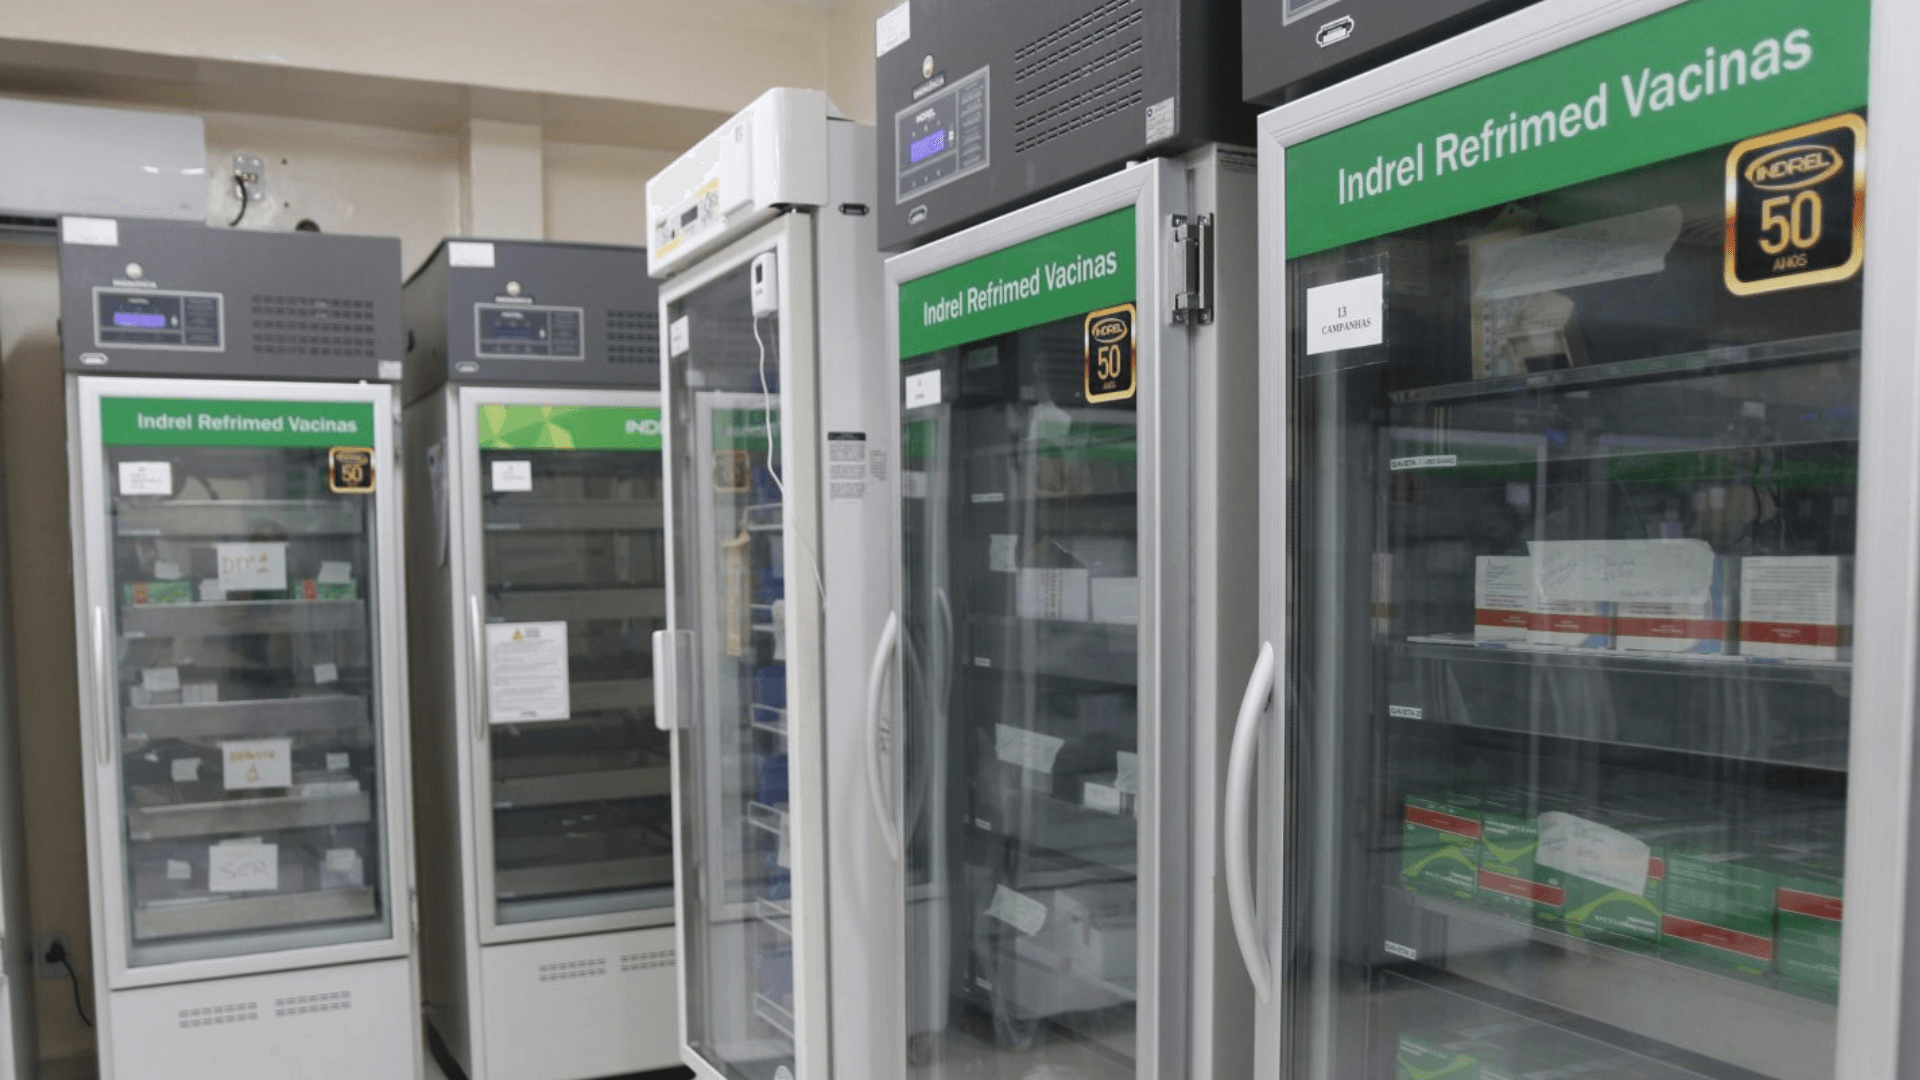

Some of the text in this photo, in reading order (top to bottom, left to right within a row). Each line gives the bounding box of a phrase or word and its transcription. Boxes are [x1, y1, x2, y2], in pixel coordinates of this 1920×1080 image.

[1337, 27, 1814, 205] Indrel Refrimed Vacinas
[1755, 151, 1831, 182] INDREL
[1758, 190, 1823, 255] 50
[1772, 252, 1808, 271] ANOS
[923, 251, 1118, 327] Indrel Refrimed Vacinas
[1321, 317, 1372, 335] CAMPANHAS
[1336, 305, 1347, 319] 13
[1097, 344, 1121, 379] 50
[137, 412, 358, 434] Indrel Refrimed Vacinas
